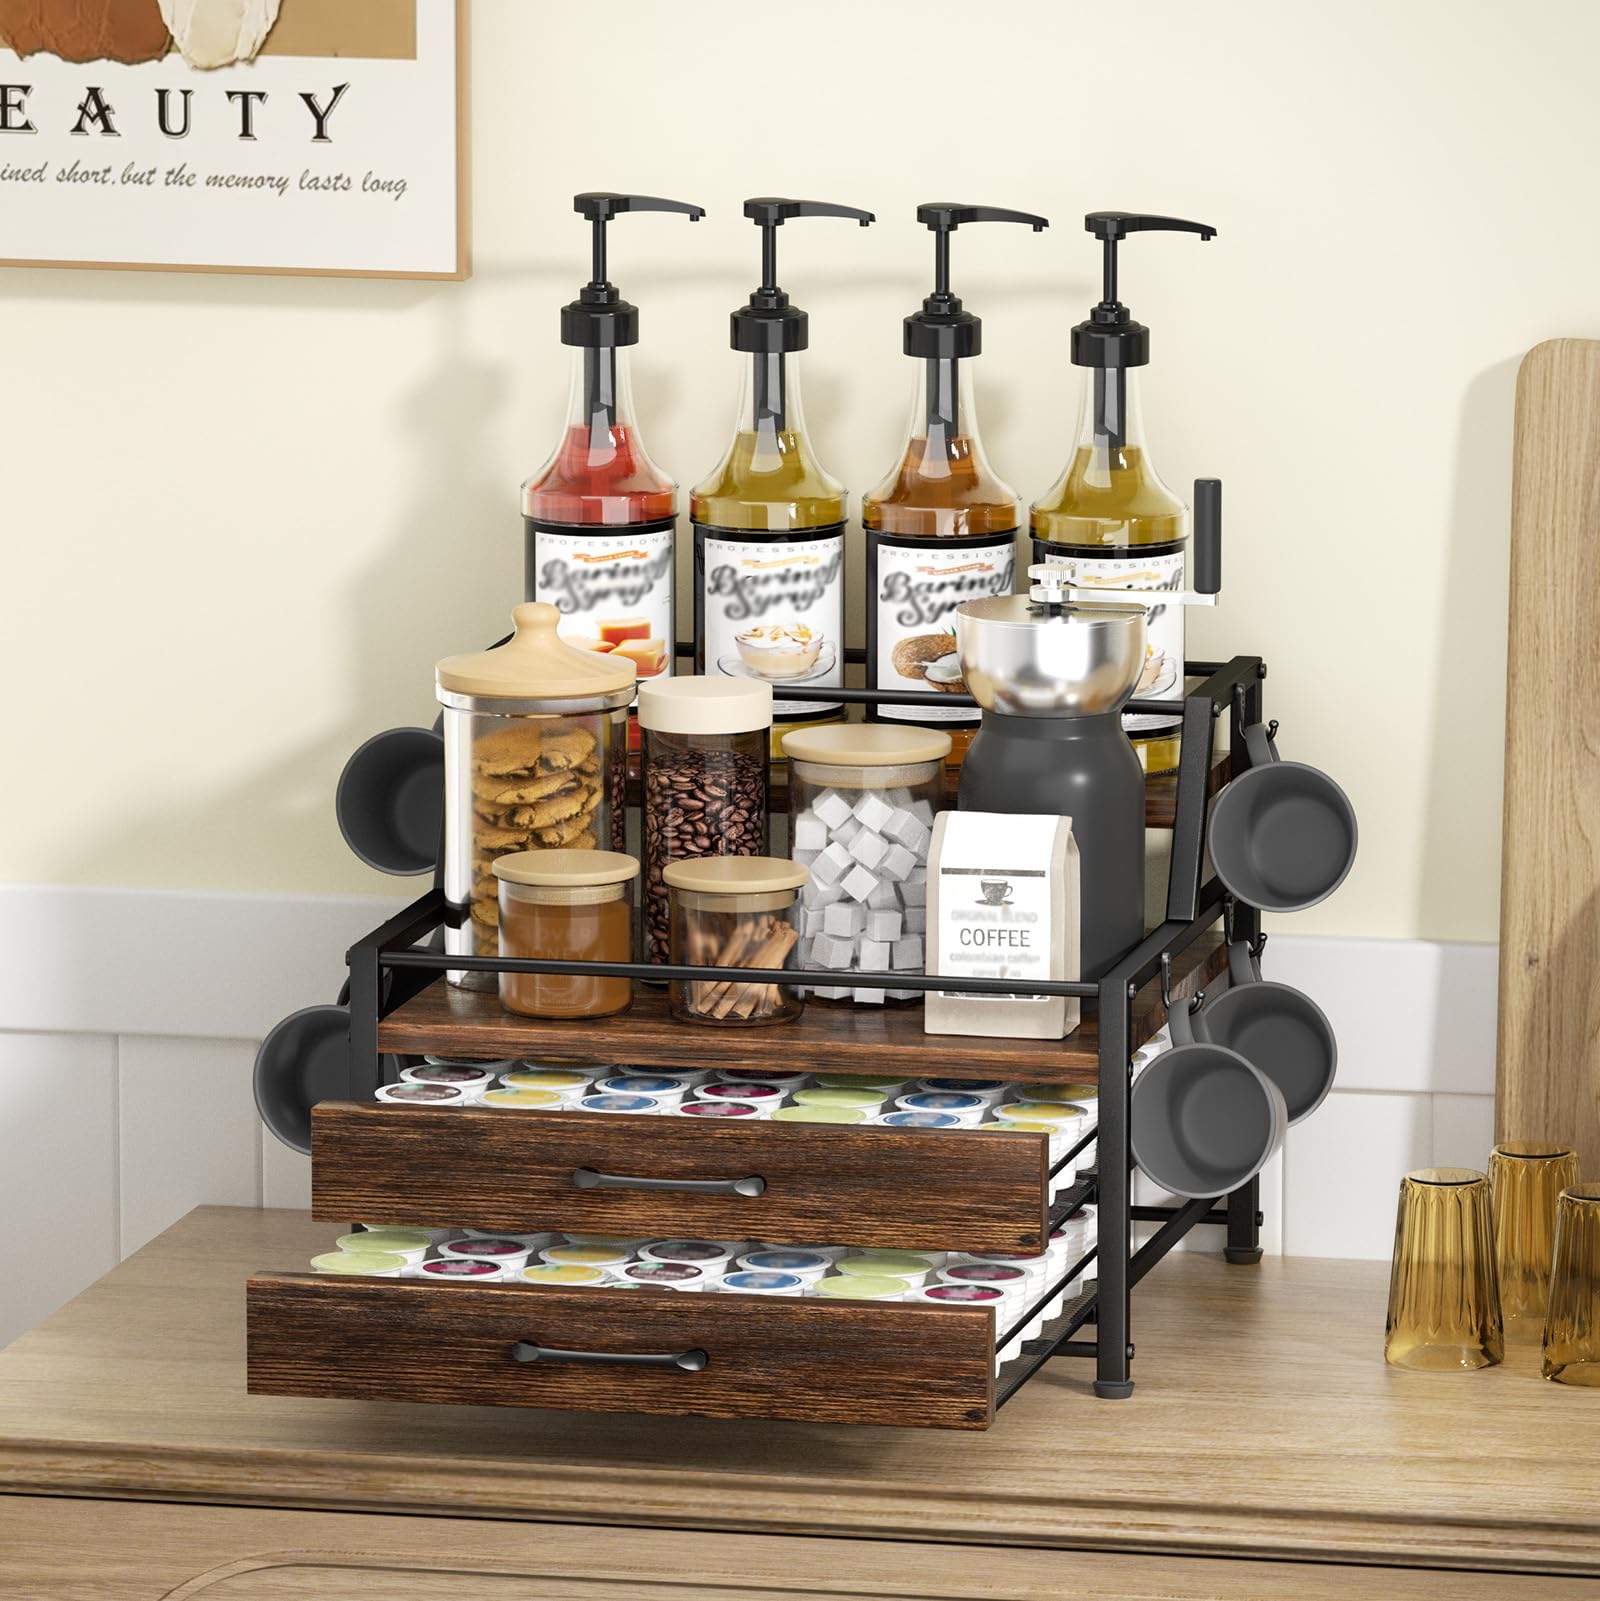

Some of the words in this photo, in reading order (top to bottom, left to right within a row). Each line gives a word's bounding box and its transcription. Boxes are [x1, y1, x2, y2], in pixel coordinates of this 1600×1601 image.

[0, 82, 352, 143] EAUTY
[164, 163, 197, 187] the
[205, 174, 290, 197] memory
[299, 169, 352, 191] lasts
[361, 171, 408, 201] long
[959, 927, 1031, 948] COFFEE
